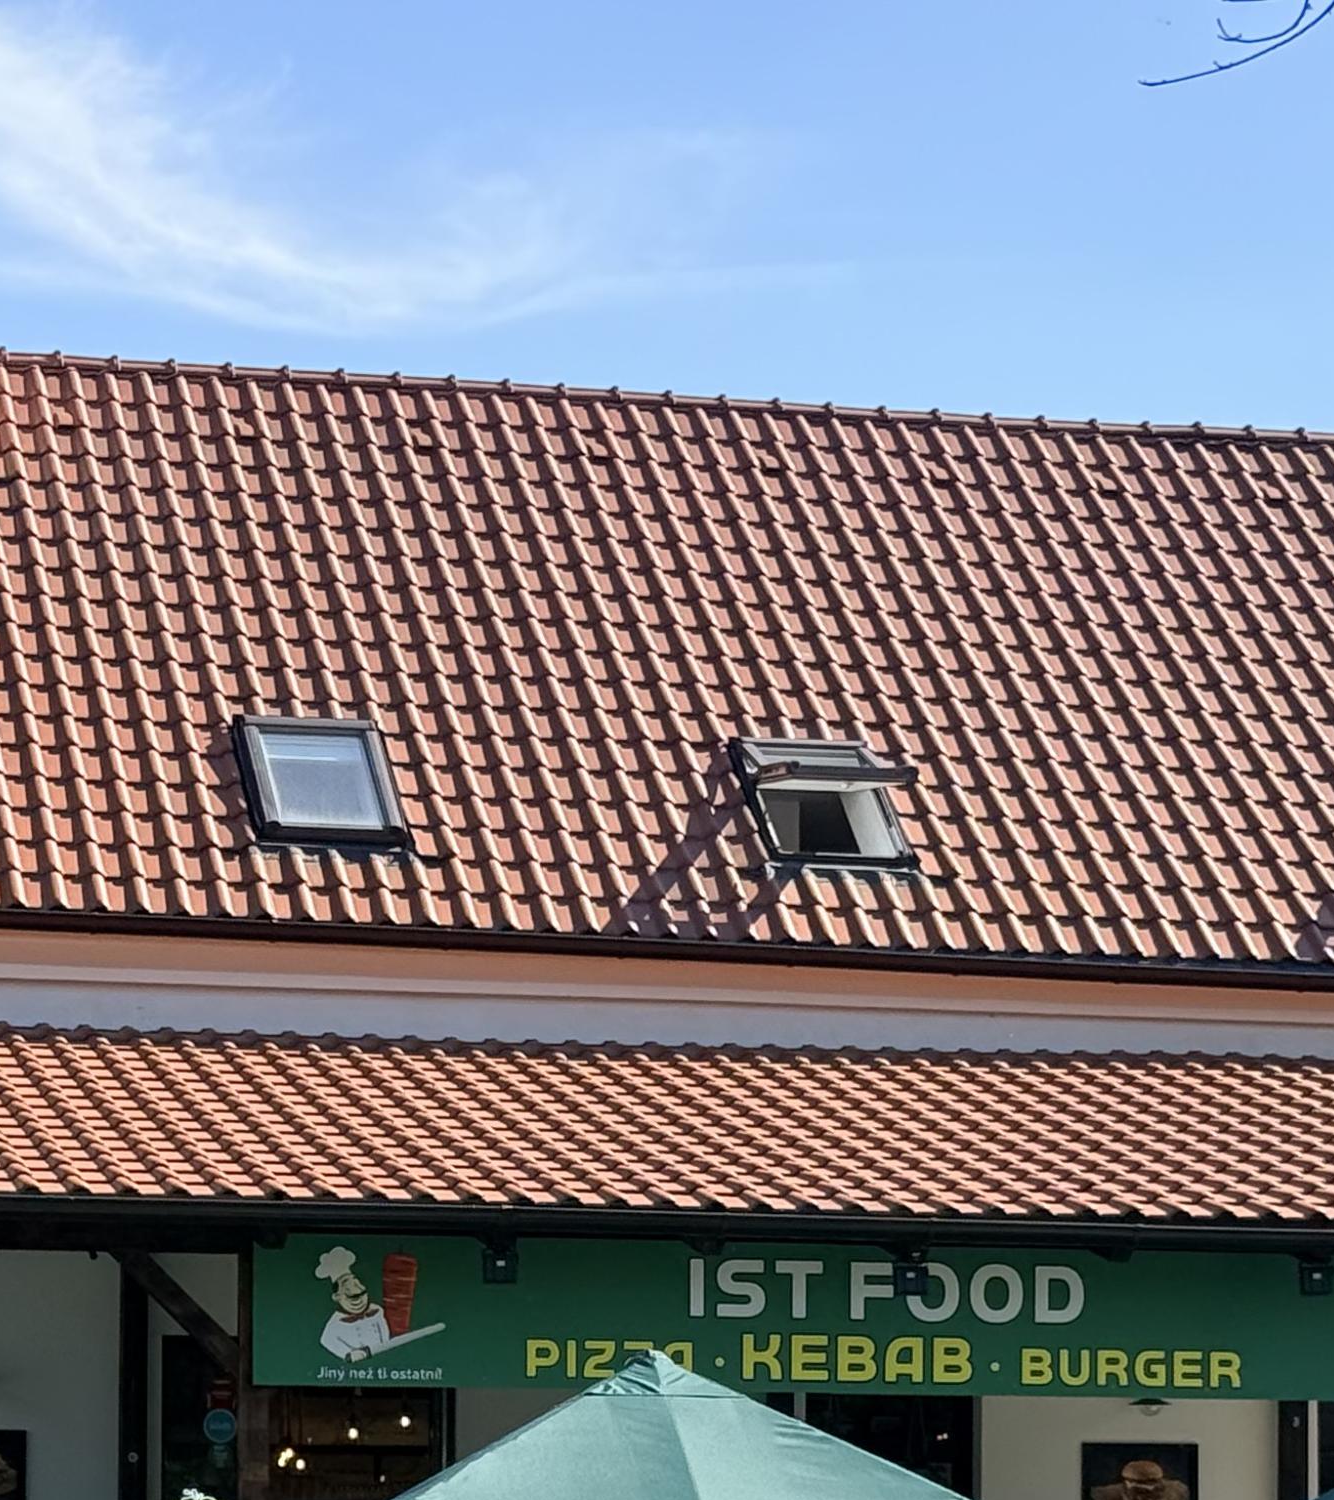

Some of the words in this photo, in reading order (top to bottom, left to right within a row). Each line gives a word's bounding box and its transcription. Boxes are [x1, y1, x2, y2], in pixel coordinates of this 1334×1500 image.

[689, 1258, 824, 1319] IST
[849, 1261, 1085, 1324] FOOD
[742, 1334, 973, 1383] KEBAB
[1020, 1347, 1243, 1389] BURGER
